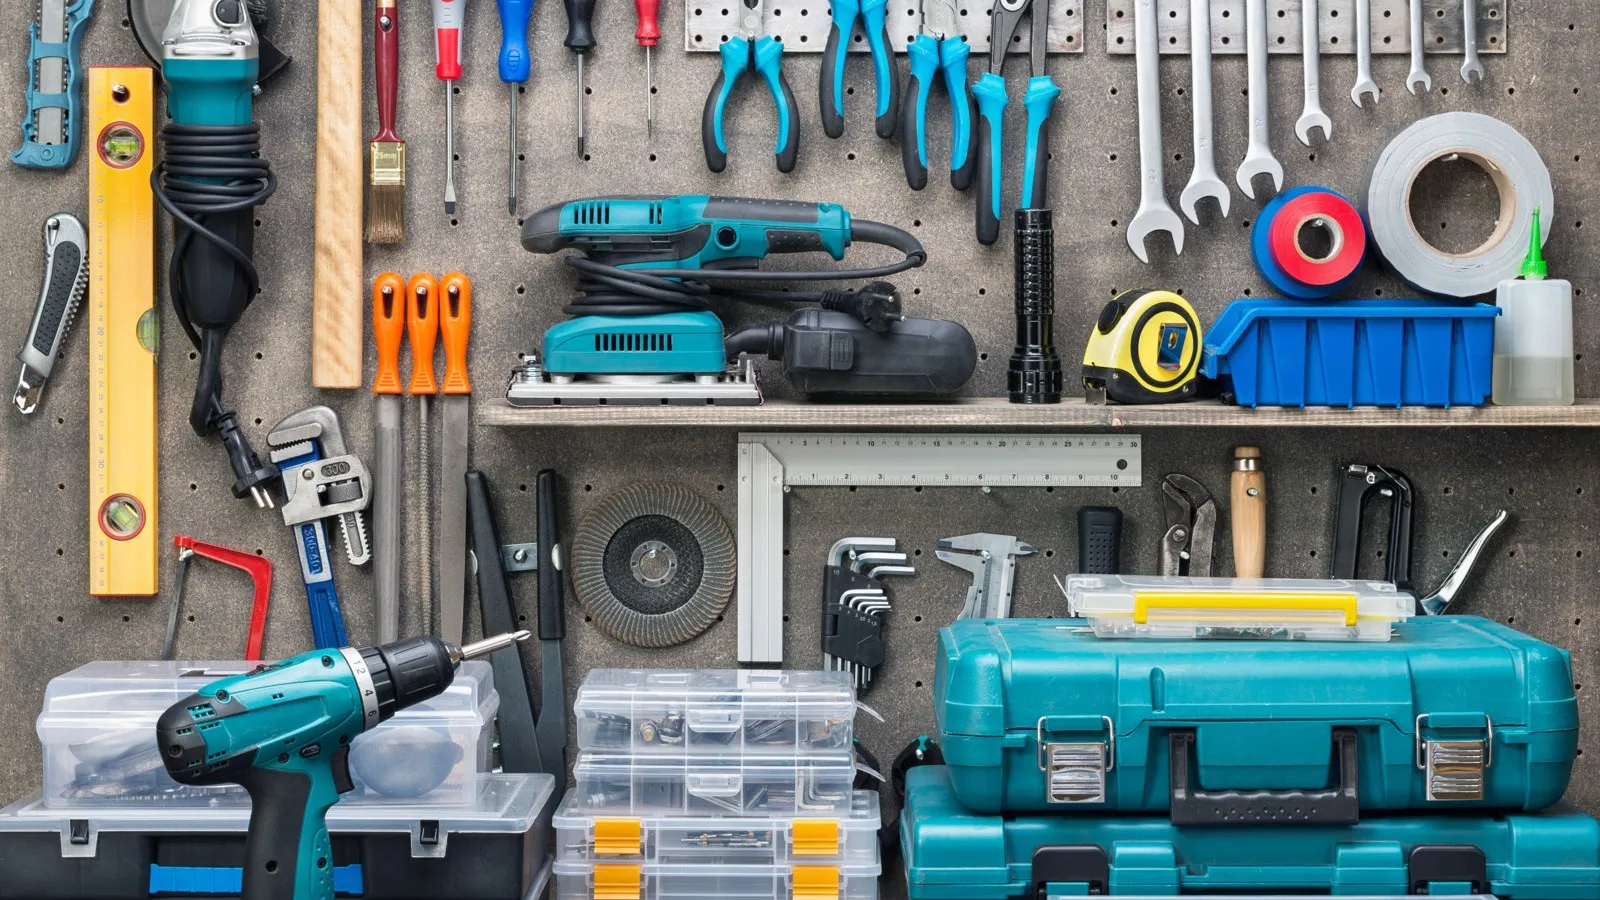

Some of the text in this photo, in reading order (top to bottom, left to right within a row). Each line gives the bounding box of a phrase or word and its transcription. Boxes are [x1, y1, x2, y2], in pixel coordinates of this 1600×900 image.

[97, 194, 104, 203] 10
[97, 327, 104, 336] 20
[97, 459, 104, 469] 30
[325, 463, 346, 476] 300
